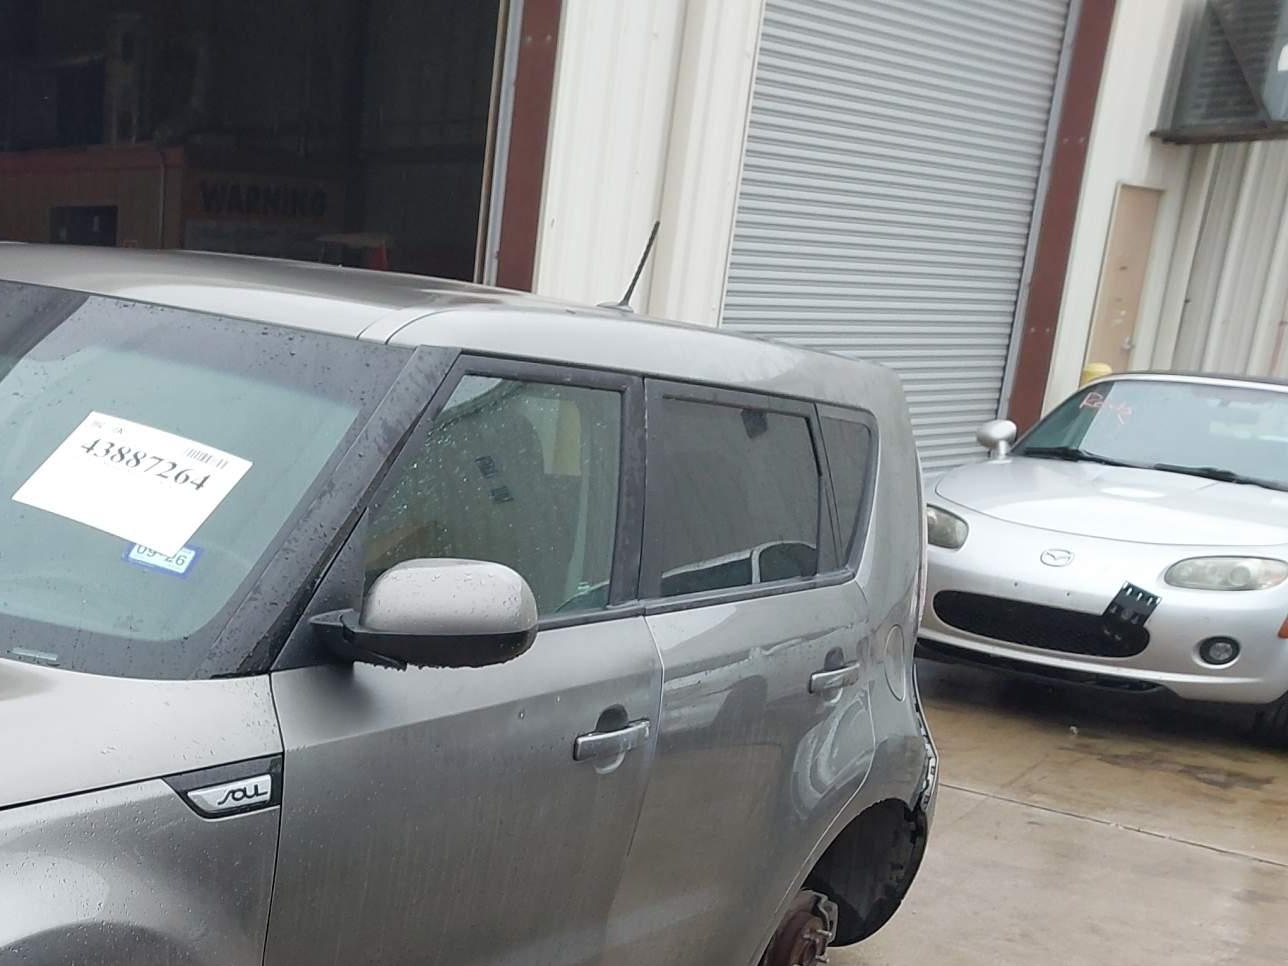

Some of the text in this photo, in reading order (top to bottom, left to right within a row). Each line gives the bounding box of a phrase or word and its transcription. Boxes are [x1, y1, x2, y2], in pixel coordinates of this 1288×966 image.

[201, 181, 328, 218] WARNING
[80, 438, 211, 491] 43887264
[217, 784, 268, 806] SOUL
